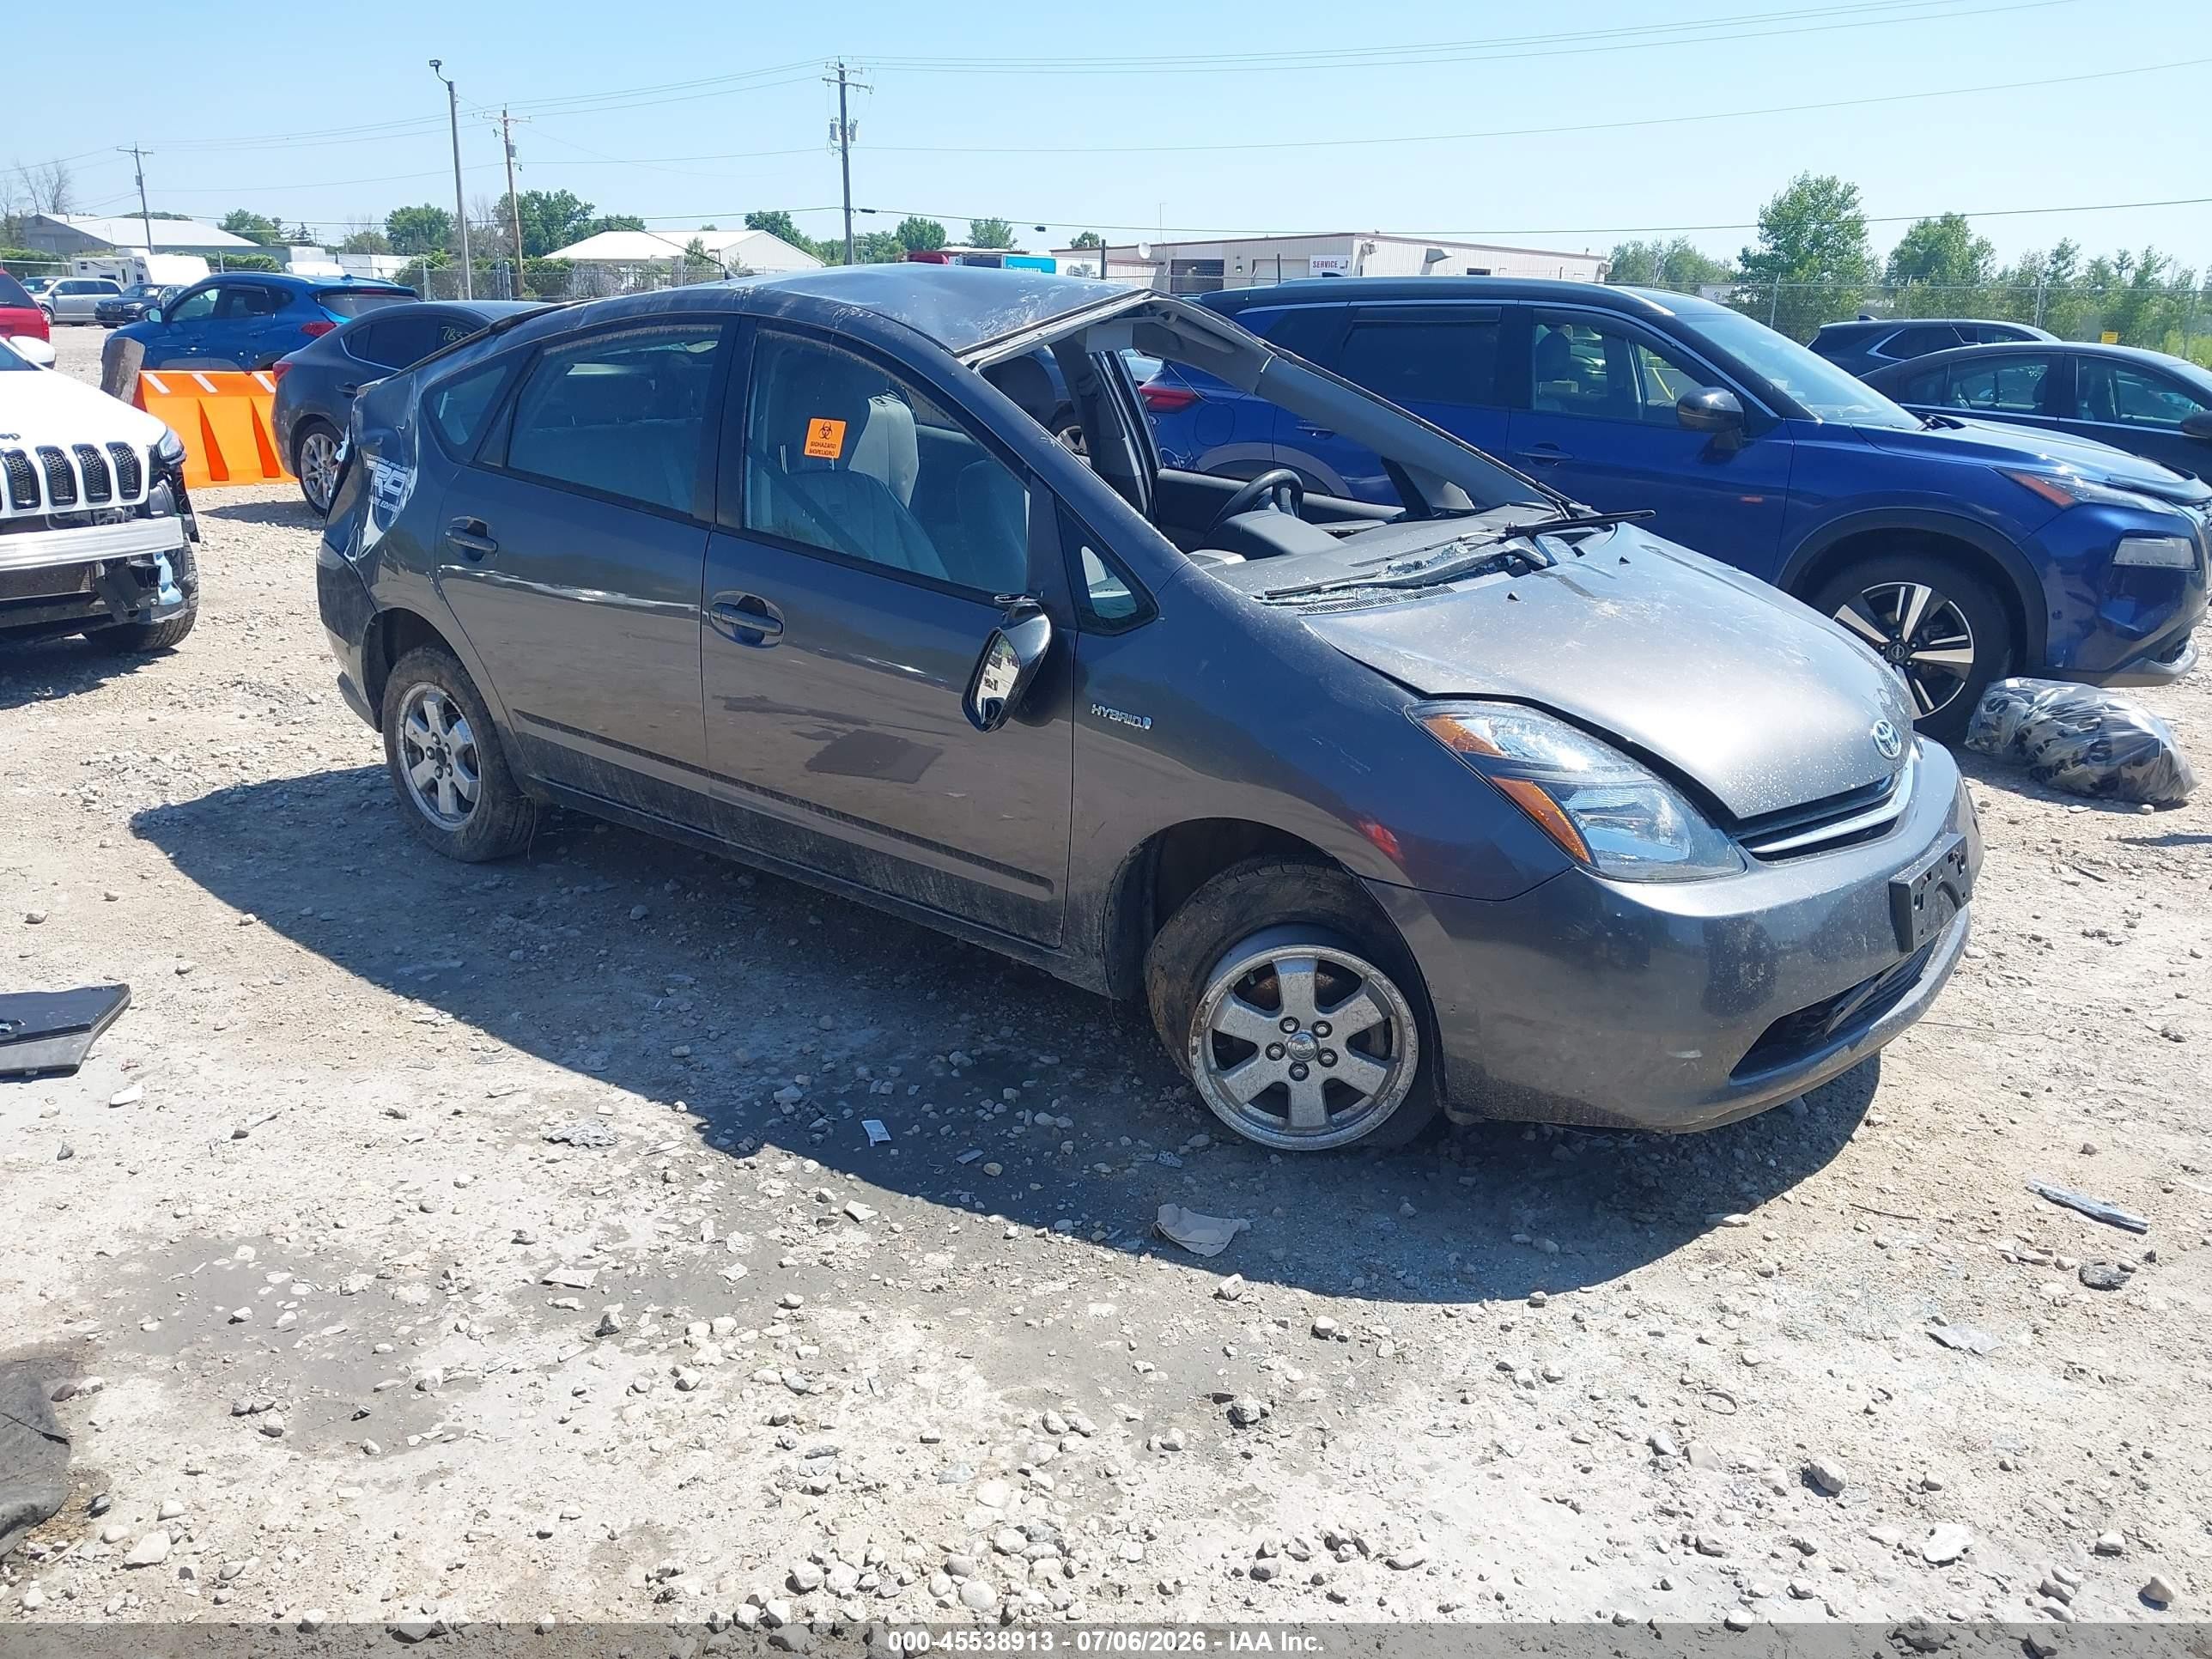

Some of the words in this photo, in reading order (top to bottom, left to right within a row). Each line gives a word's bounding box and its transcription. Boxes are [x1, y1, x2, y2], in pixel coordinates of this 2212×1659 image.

[1312, 260, 1339, 269] SERVICE
[810, 441, 836, 449] BIOHAZARD
[808, 447, 836, 456] BIOPELIGRO
[1091, 703, 1144, 728] HYBRID
